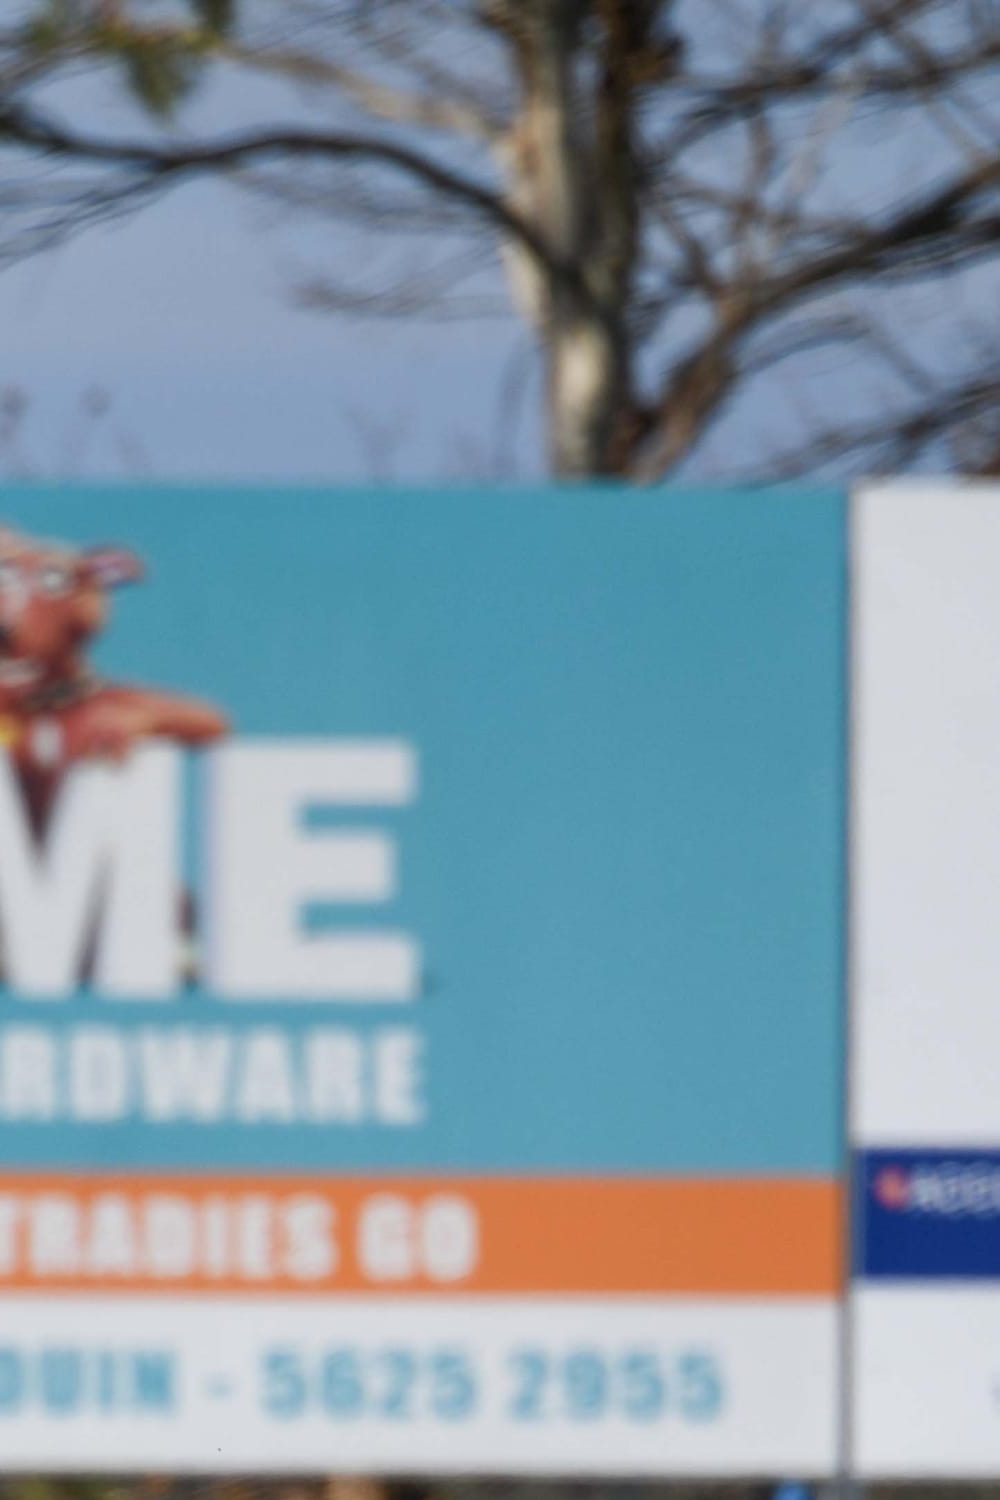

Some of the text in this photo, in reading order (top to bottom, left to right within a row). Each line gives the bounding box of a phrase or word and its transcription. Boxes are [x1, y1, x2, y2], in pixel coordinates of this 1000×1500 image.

[357, 1196, 481, 1284] GO
[259, 1345, 479, 1422] 5625
[508, 1349, 728, 1425] 2955
